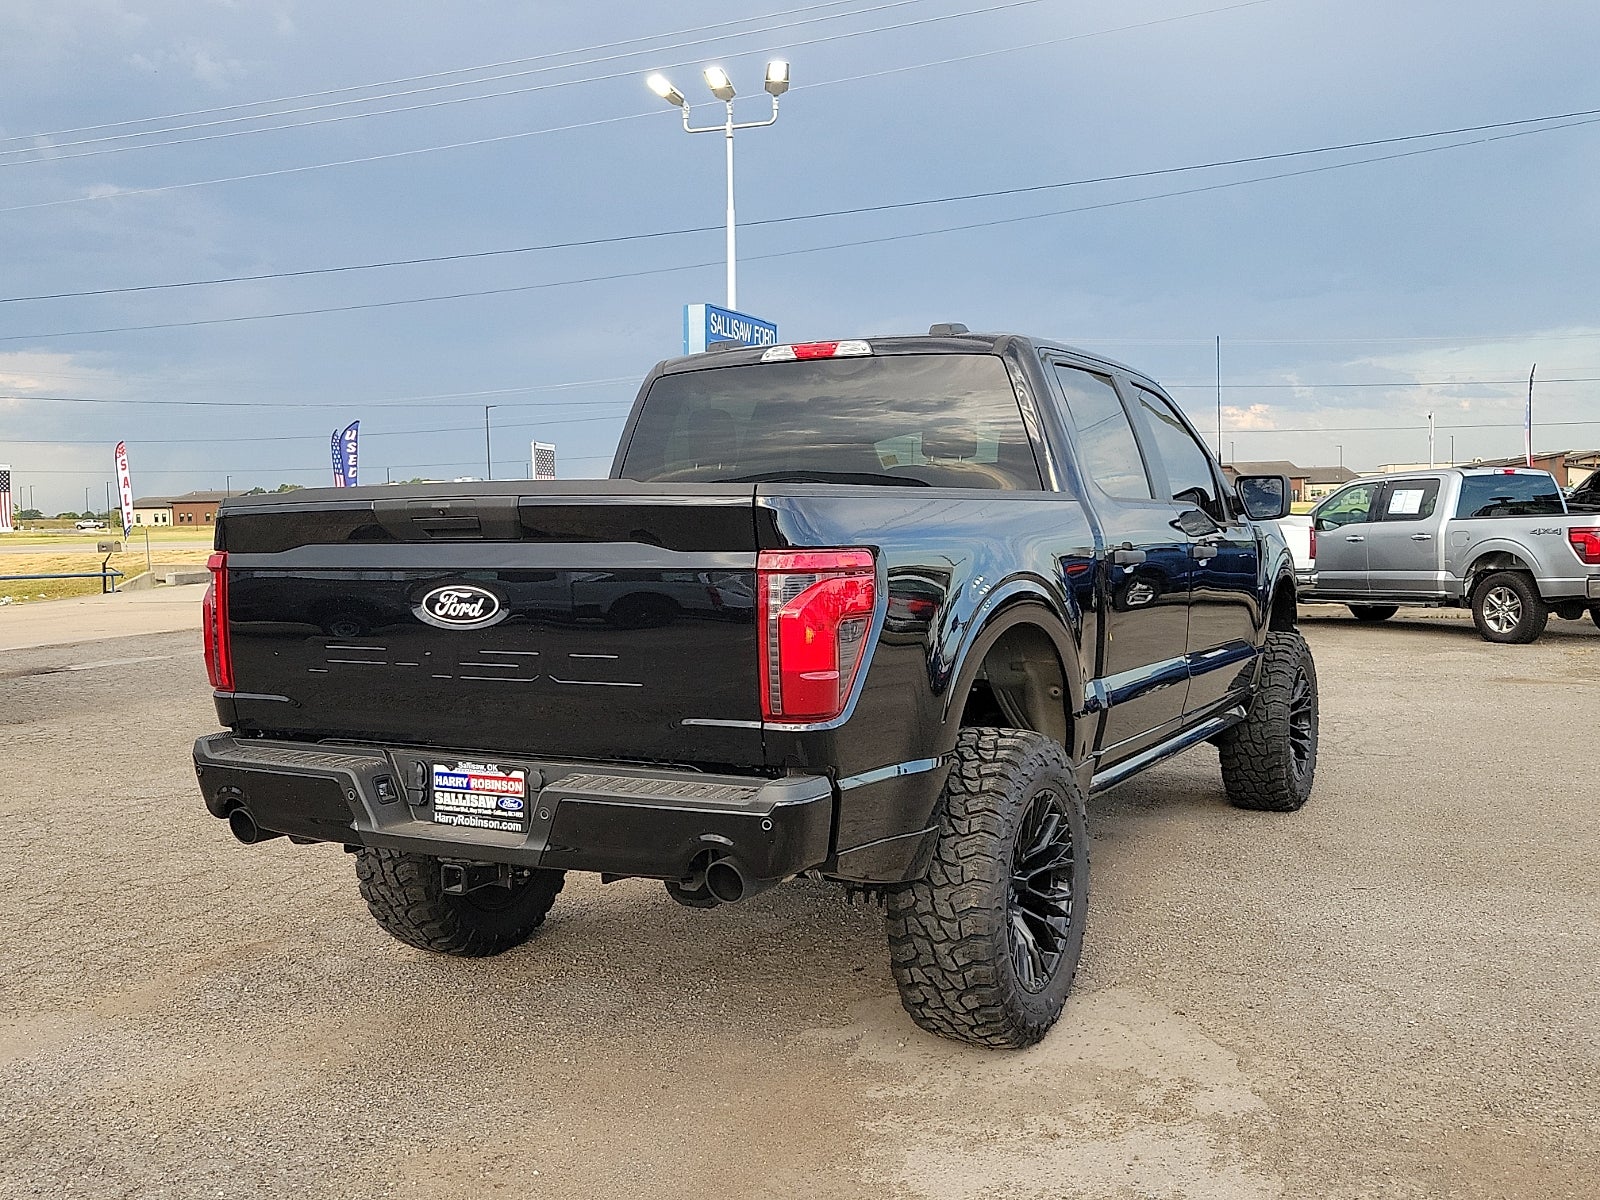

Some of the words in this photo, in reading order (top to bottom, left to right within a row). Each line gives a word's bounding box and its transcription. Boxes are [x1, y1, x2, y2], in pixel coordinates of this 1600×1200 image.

[710, 313, 752, 342] SALLISAW
[754, 325, 776, 346] FORD
[120, 459, 131, 524] SALE
[434, 590, 485, 617] Ford
[487, 764, 498, 772] OK
[435, 775, 468, 788] HARRY
[470, 778, 523, 792] ROBINSON
[434, 791, 498, 809] SALLISAW
[434, 812, 522, 832] HarryRobinson.com
